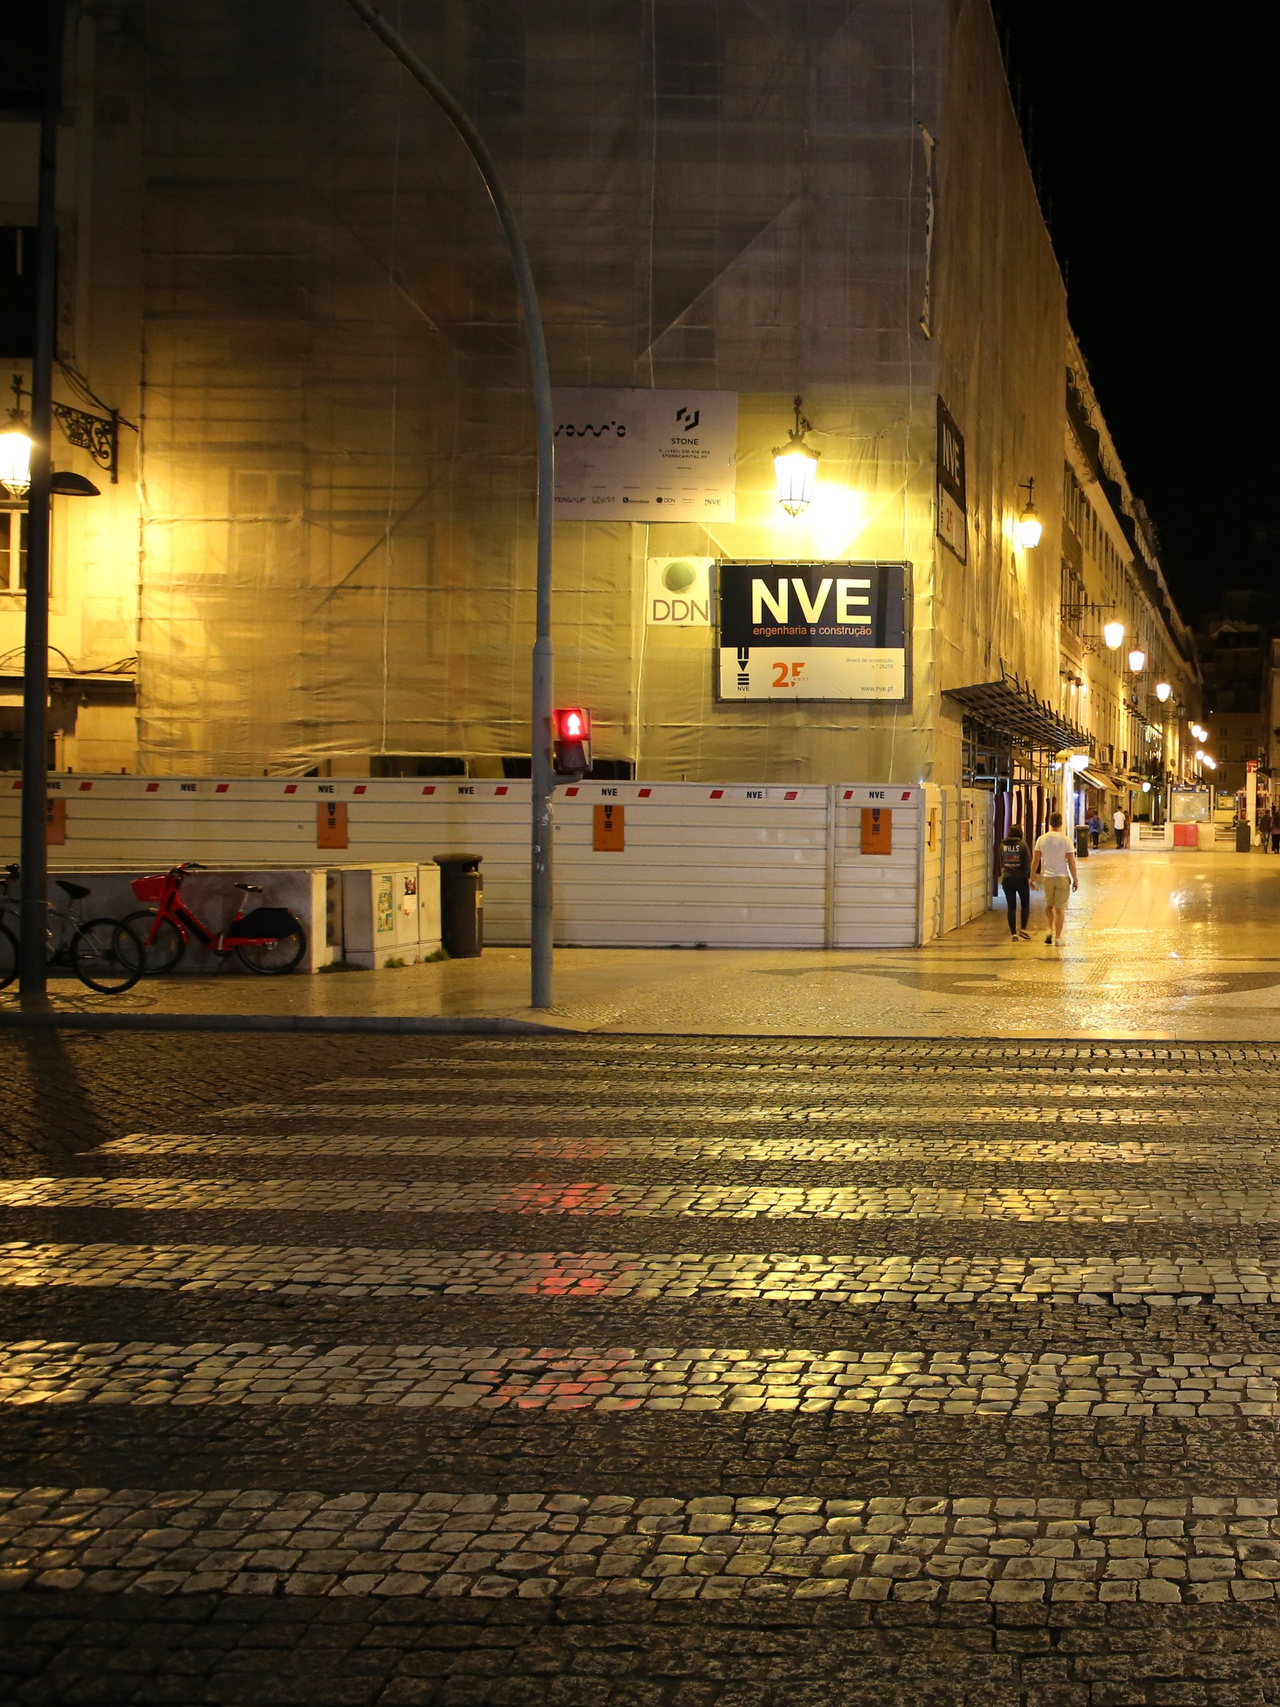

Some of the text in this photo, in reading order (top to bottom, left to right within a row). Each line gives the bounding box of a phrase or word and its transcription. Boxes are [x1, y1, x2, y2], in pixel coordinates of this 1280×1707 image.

[670, 437, 700, 446] STONE
[943, 422, 961, 488] NVE
[751, 578, 872, 624] NVE
[652, 599, 709, 621] DDN
[752, 625, 873, 638] engenharia e construção
[180, 783, 197, 792] NVE
[318, 785, 335, 794] NVE
[458, 786, 475, 795] NVE
[601, 788, 618, 797] NVE
[746, 790, 763, 799] NVE
[869, 790, 885, 799] NVE
